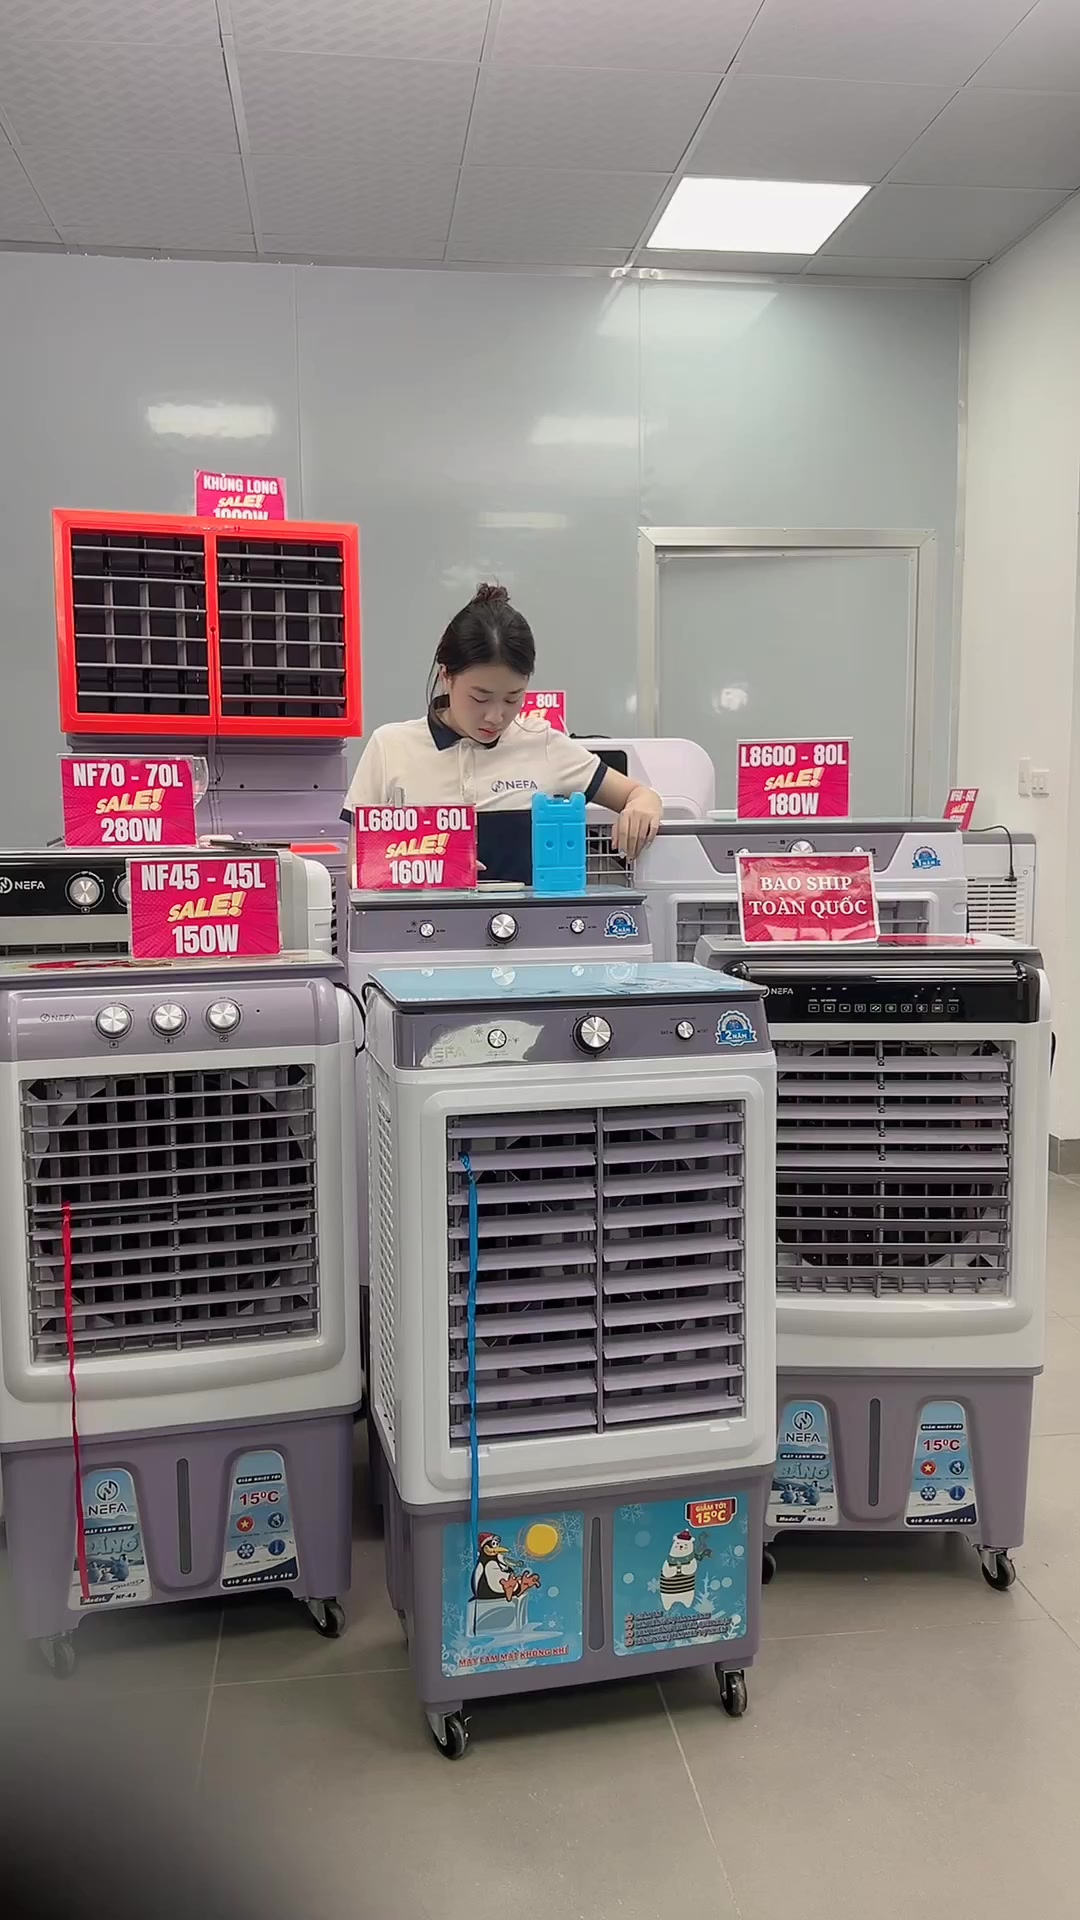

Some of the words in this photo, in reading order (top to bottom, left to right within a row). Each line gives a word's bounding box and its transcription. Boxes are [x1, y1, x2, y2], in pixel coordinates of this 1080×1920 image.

[203, 473, 244, 492] KHỦNG
[247, 479, 279, 495] LONG
[218, 494, 266, 509] SALE!
[536, 693, 560, 709] 80L
[741, 745, 796, 767] L8600
[813, 744, 847, 765] 80L
[72, 763, 126, 787] NF70
[145, 764, 183, 787] 70L
[505, 780, 538, 790] NEFA
[764, 767, 825, 791] SALE!
[95, 788, 166, 815] SALE!
[768, 793, 819, 815] 180W
[100, 817, 163, 843] 280W
[358, 809, 417, 832] L6800
[436, 808, 471, 831] 60L
[385, 833, 450, 859] SALE!
[141, 864, 200, 891] NF45
[223, 862, 267, 889] 45L
[389, 860, 444, 885] 160W
[760, 876, 802, 891] BAO
[806, 876, 853, 891] SHIP
[14, 881, 46, 890] NEFA
[167, 890, 247, 923] SALE!
[749, 896, 806, 915] TOÀN
[810, 895, 868, 919] QUỐC
[172, 924, 239, 955] 150W
[770, 987, 794, 996] NEFA
[725, 1030, 733, 1041] 2
[785, 1432, 821, 1443] NEFA
[87, 1502, 128, 1517] NEFA
